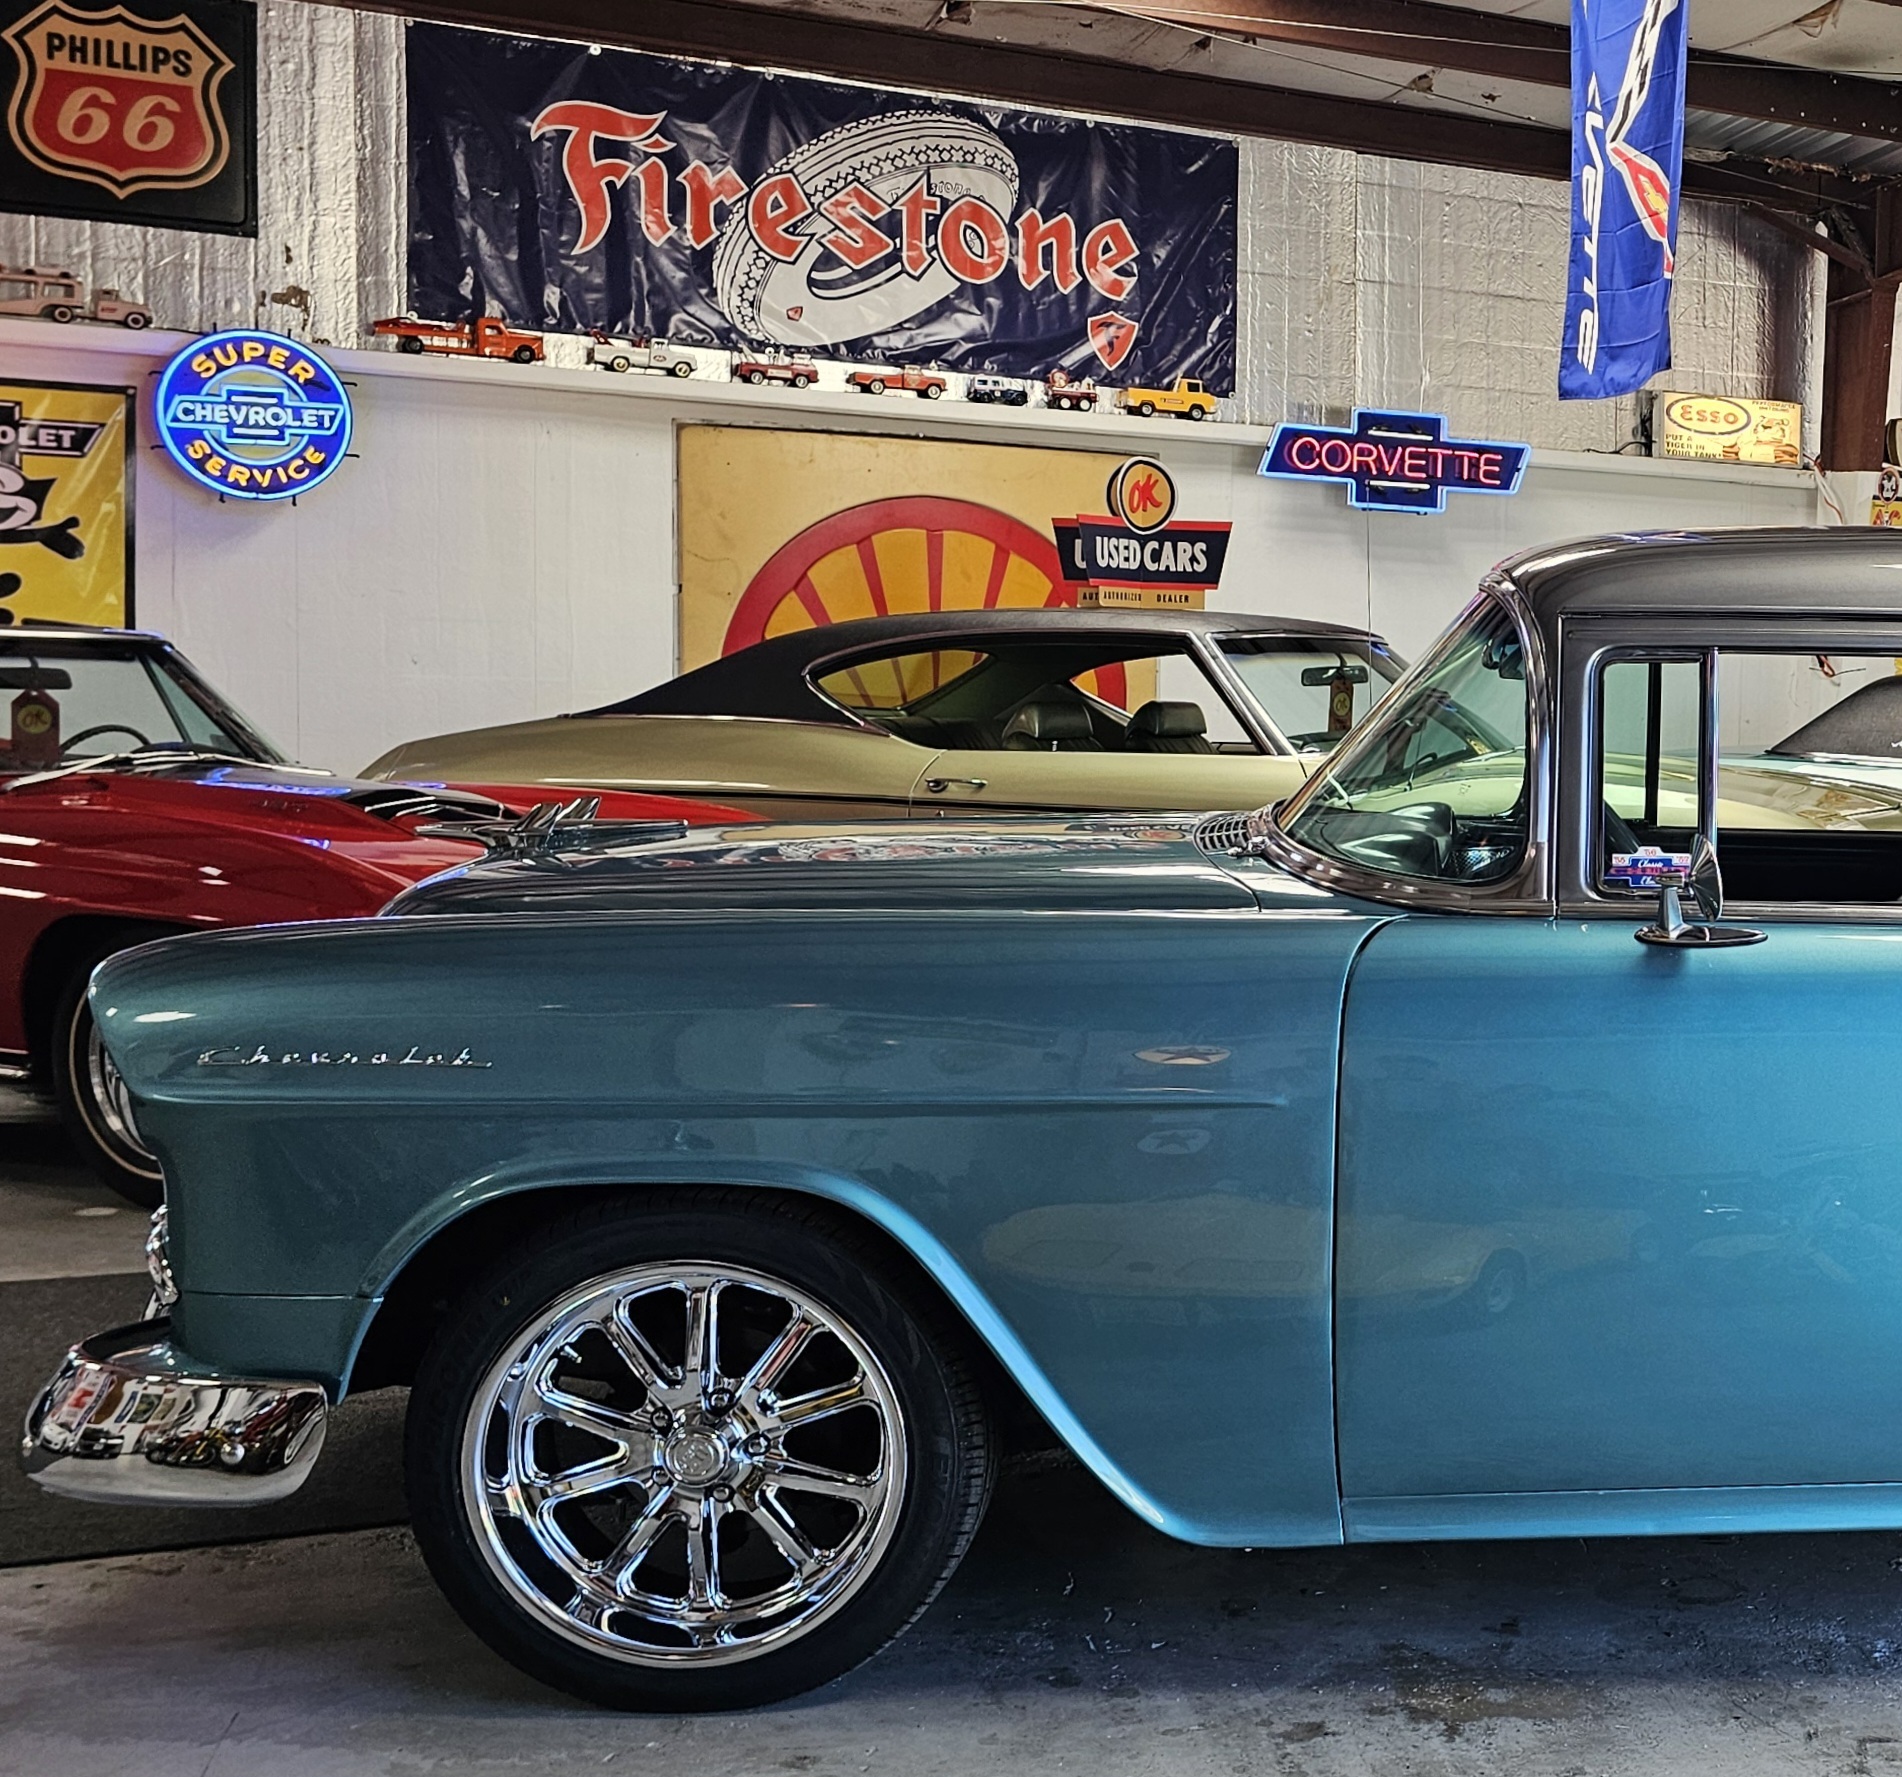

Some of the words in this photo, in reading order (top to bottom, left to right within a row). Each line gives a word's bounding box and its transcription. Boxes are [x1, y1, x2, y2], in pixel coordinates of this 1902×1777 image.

[45, 31, 194, 79] PHILLIPS
[56, 86, 183, 152] 66
[530, 100, 1141, 300] Firestone
[191, 341, 316, 384] SUPER
[176, 402, 336, 429] CHEVROLET
[1665, 433, 1683, 441] PUT
[1666, 441, 1692, 450] TIGER
[185, 439, 326, 488] SERVICE
[1291, 436, 1504, 486] CORVETTE
[1128, 473, 1163, 514] OK
[1095, 536, 1142, 570] USED
[1143, 541, 1208, 572] CARS
[1103, 590, 1142, 602] AUTHORIZED
[1156, 593, 1190, 604] DEALER
[197, 1044, 492, 1068] Chevrolet
